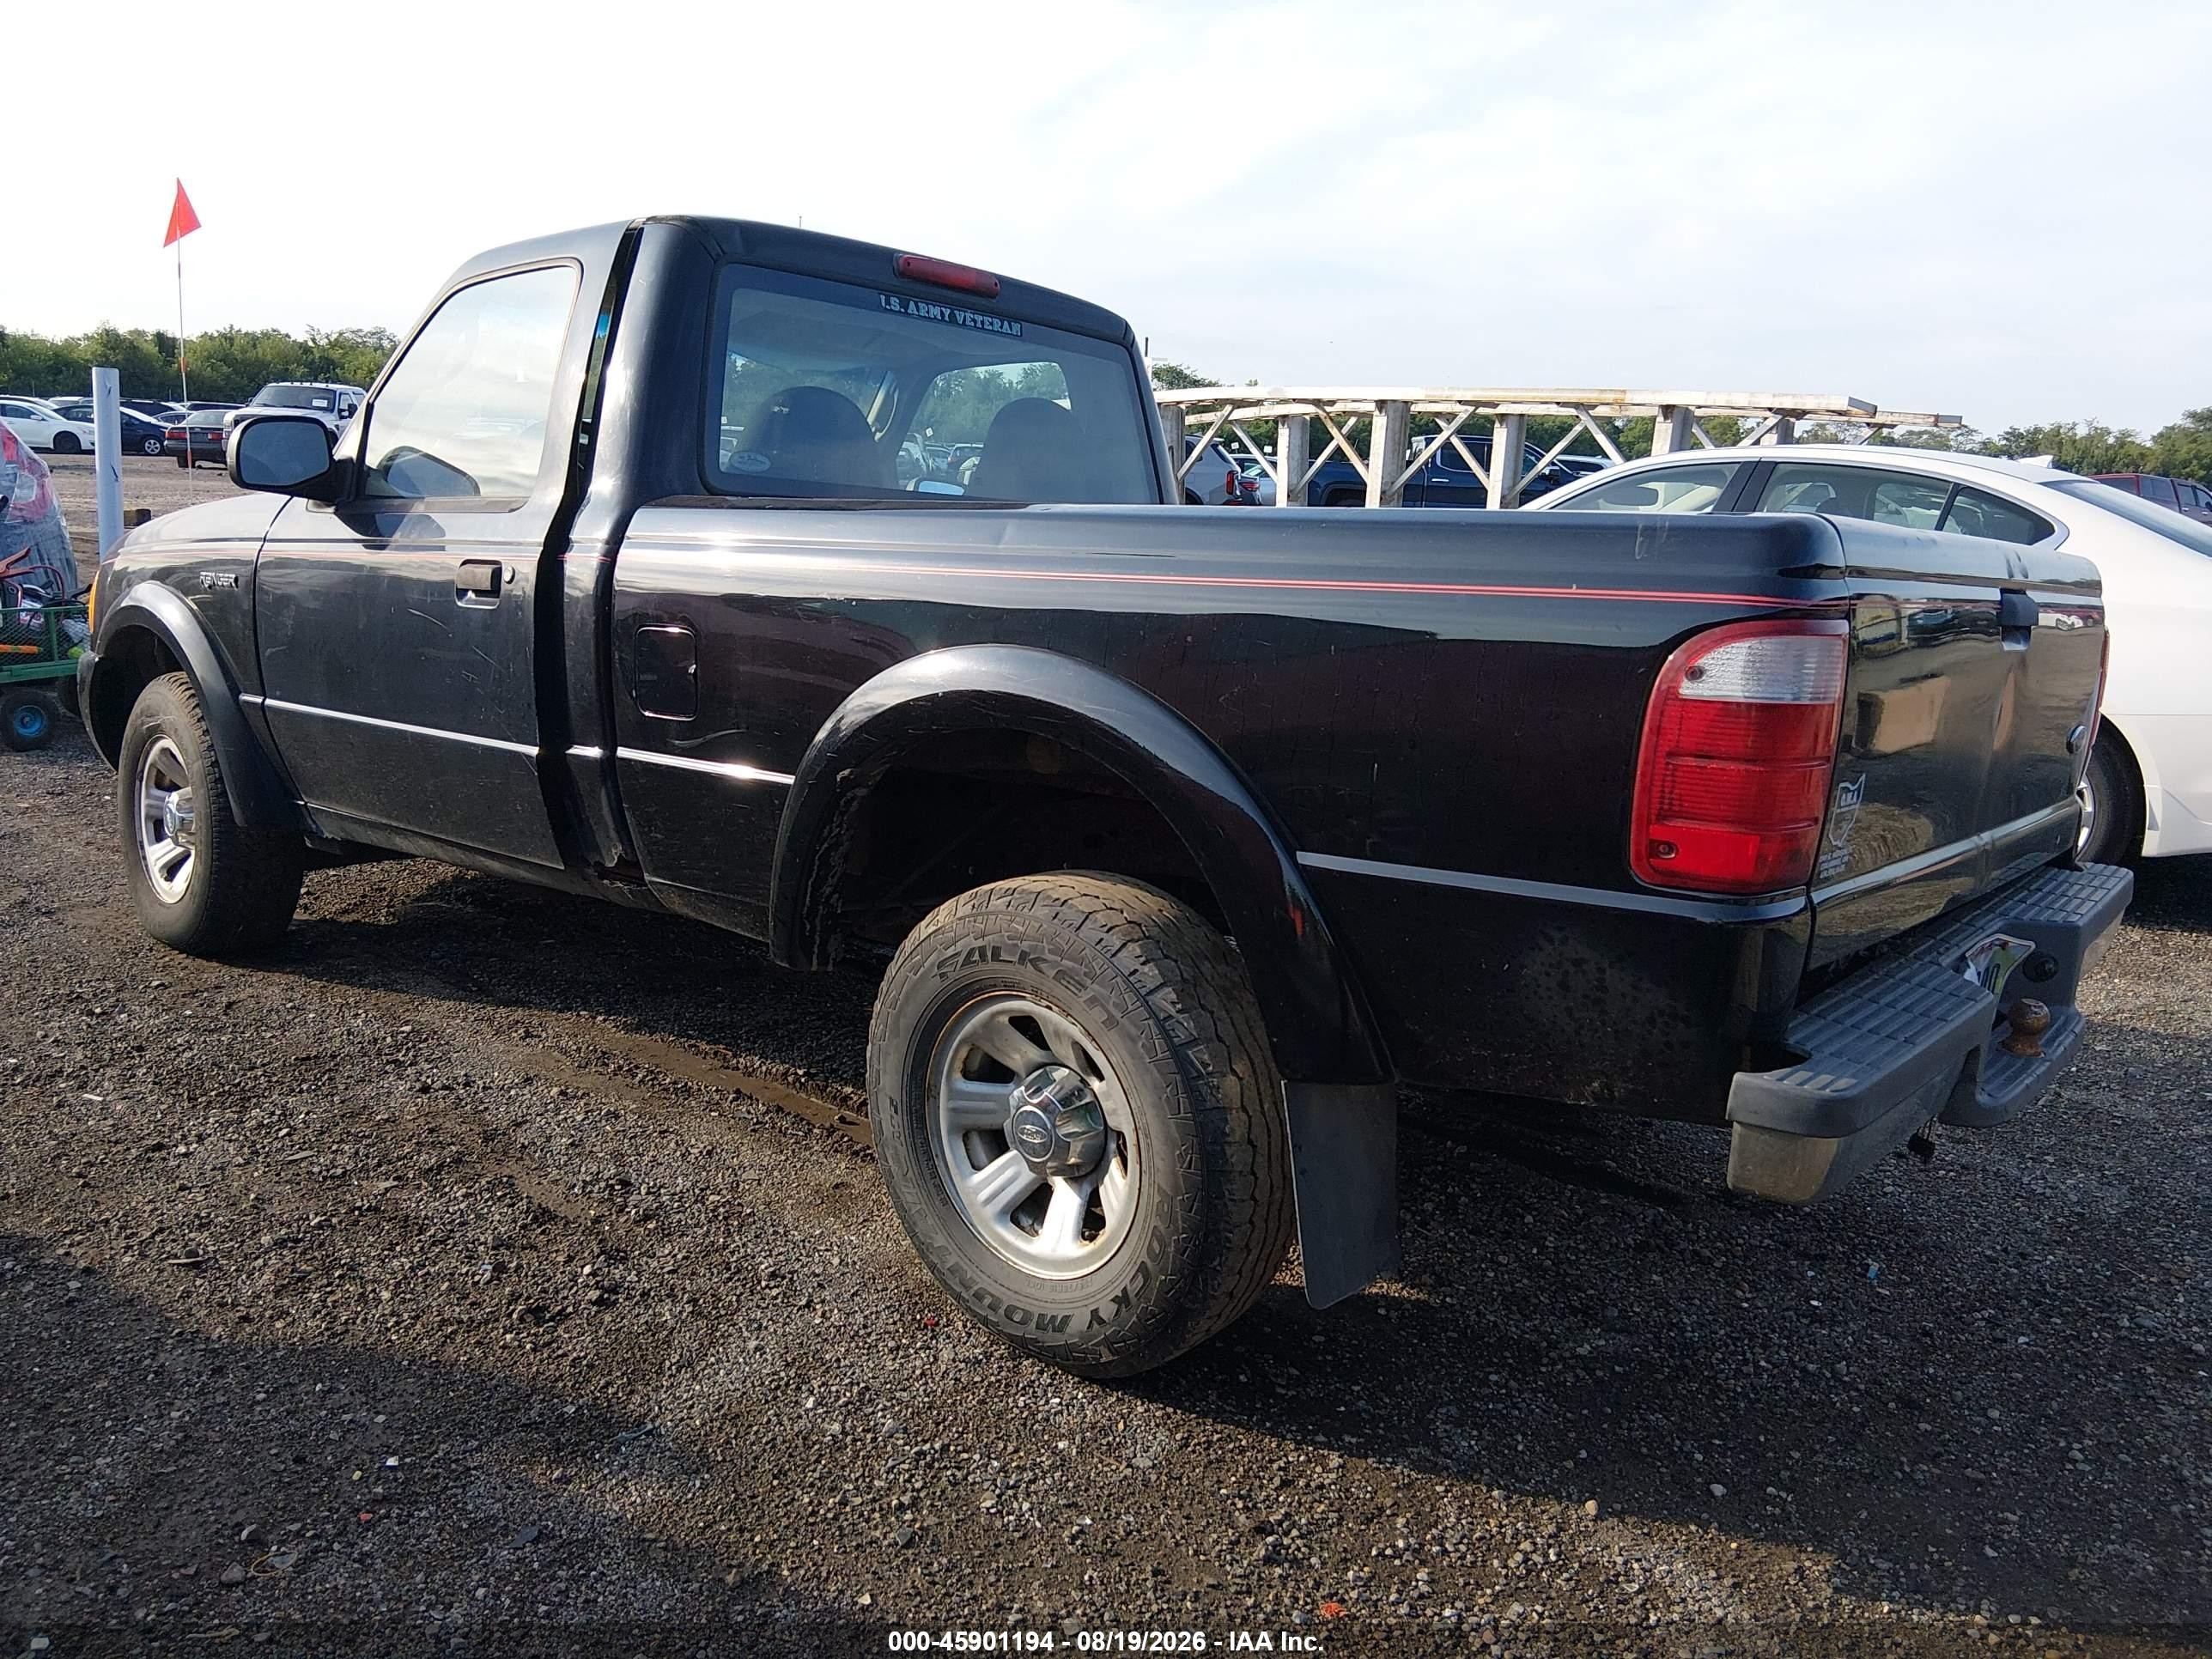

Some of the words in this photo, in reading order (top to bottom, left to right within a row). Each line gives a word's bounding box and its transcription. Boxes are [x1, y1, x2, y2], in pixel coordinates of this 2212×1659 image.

[908, 300, 951, 322] ARMY
[953, 309, 1021, 337] VETERAN
[932, 945, 1119, 1031] FALKEN
